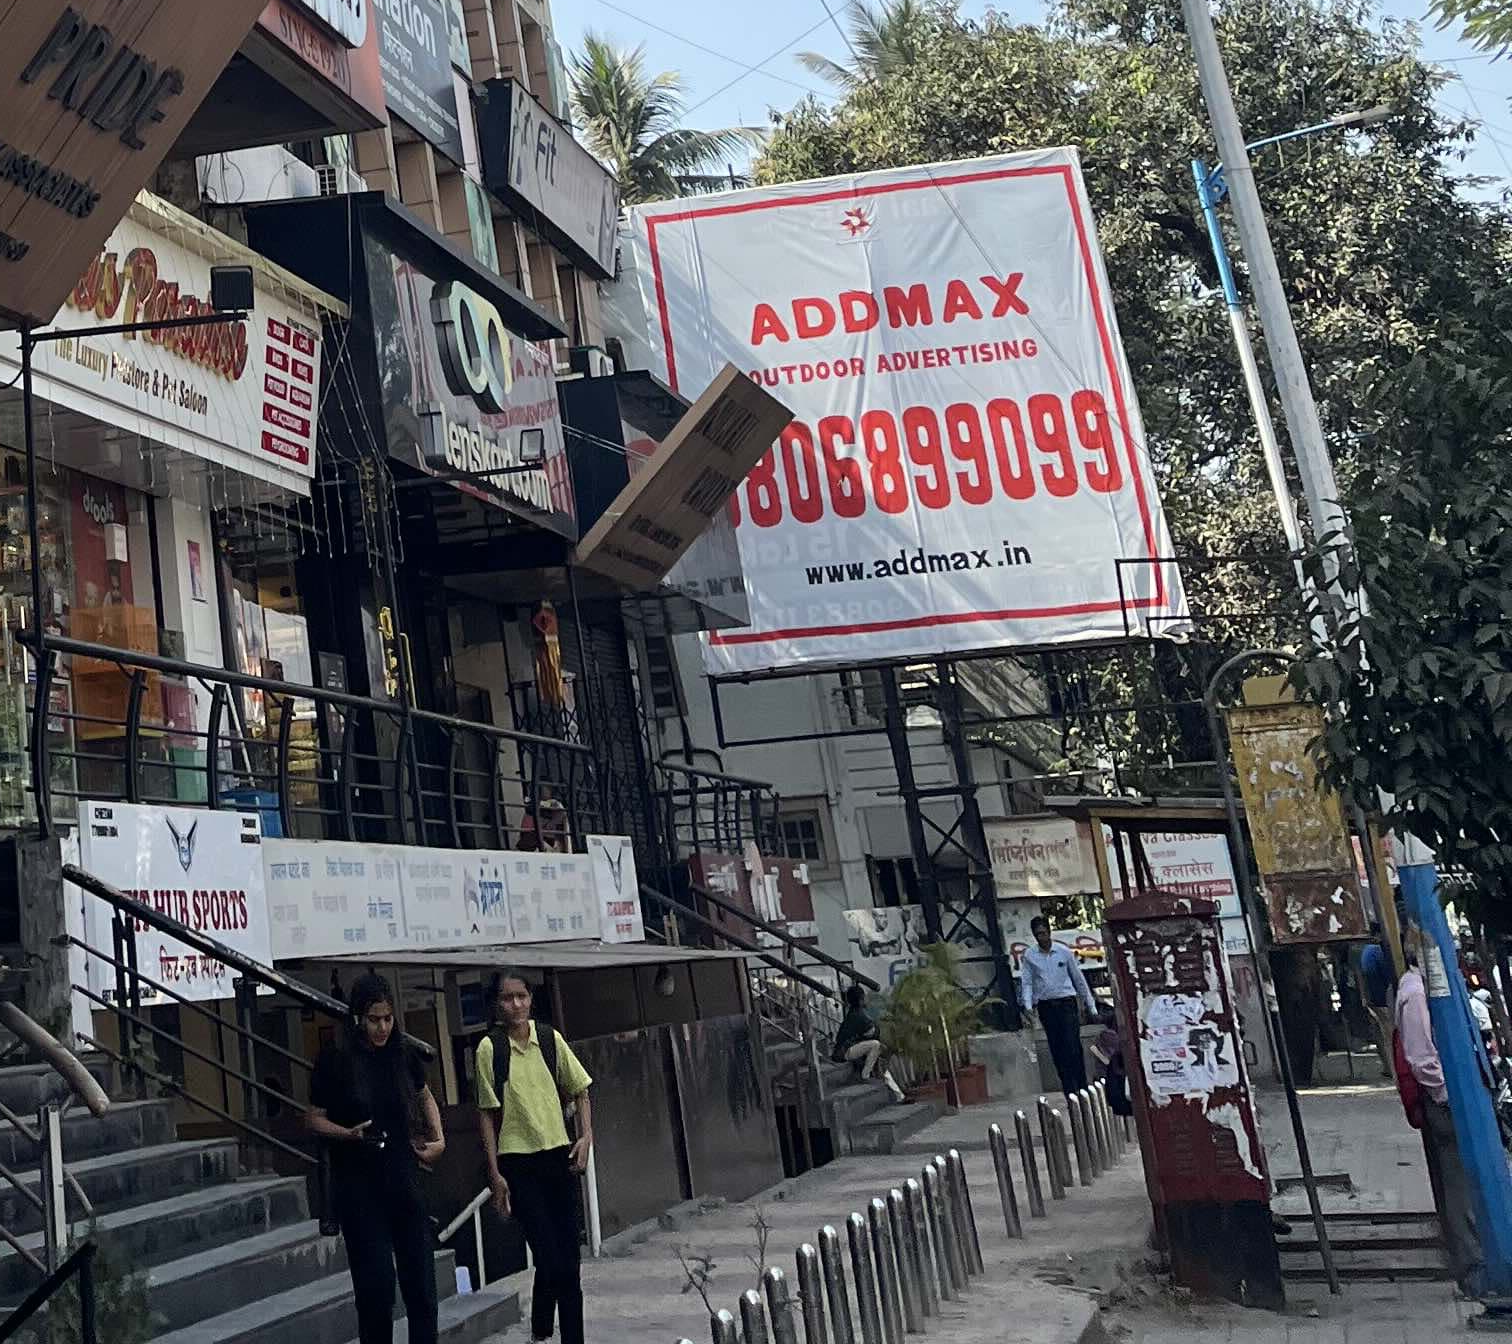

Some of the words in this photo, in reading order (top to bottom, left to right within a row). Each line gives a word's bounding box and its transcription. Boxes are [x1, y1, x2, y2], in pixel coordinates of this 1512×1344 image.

[17, 6, 187, 153] PRIDE
[536, 119, 557, 188] Fit
[749, 271, 1030, 347] ADDMAX
[75, 345, 109, 383] Luxury
[178, 381, 209, 417] Saloon
[747, 356, 866, 389] OUTDOOR
[875, 338, 1039, 374] ADVERTISING
[729, 387, 1124, 531] 806899099
[804, 540, 1033, 588] www.addmax.in
[192, 889, 249, 931] SPORTS
